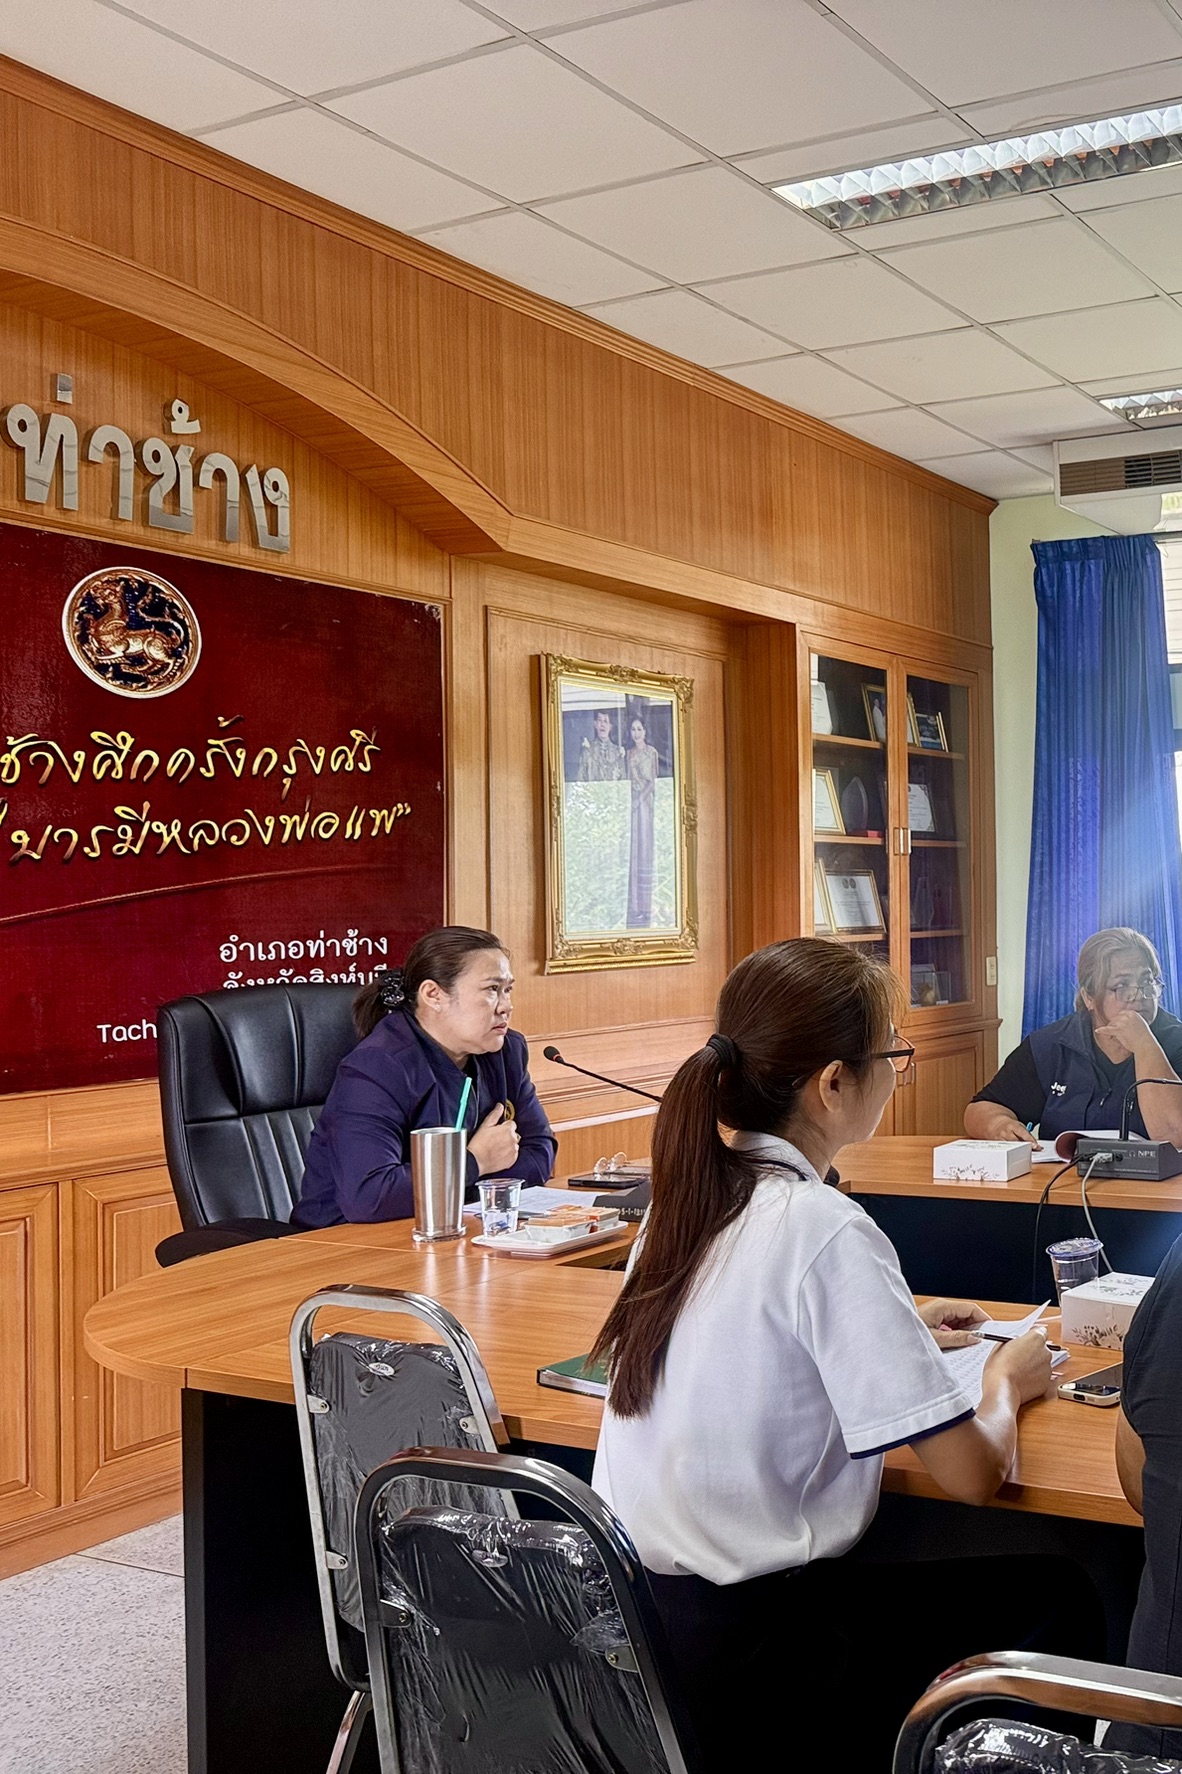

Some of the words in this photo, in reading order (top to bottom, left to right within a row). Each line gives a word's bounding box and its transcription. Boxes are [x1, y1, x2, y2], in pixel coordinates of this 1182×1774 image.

[4, 373, 290, 553] ท่าช้าง
[219, 929, 388, 963] อำเภอท่าช้าง
